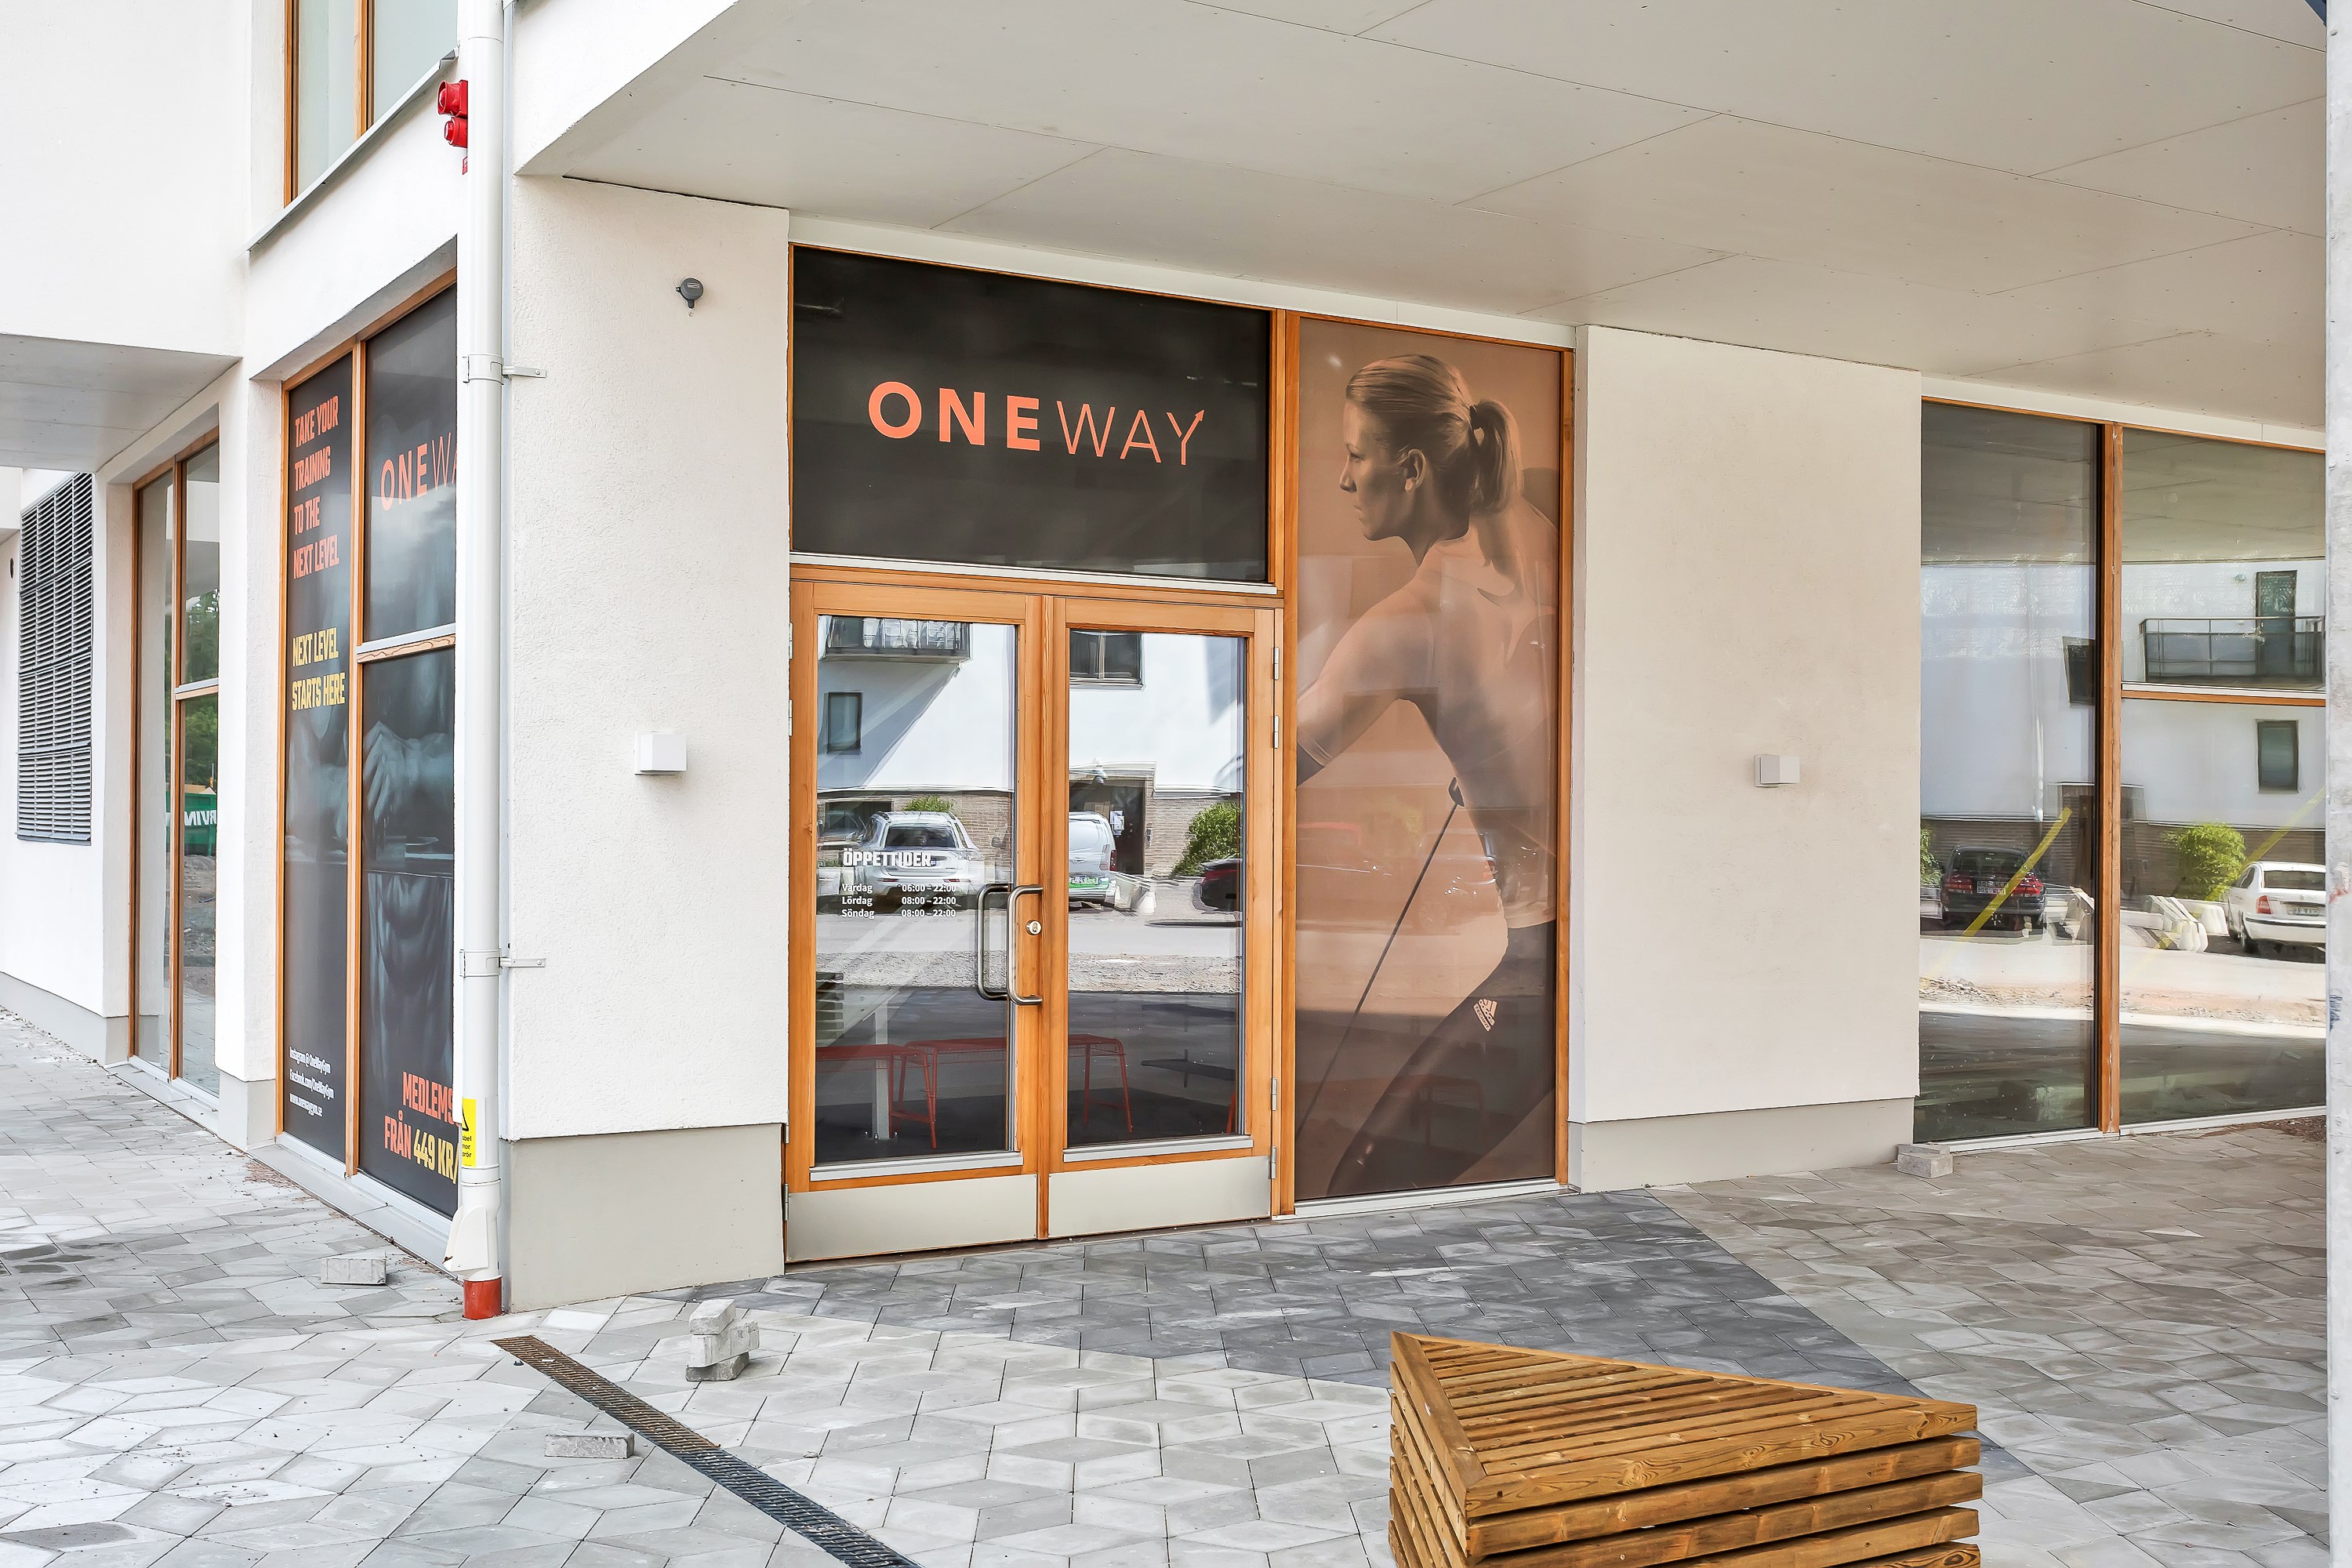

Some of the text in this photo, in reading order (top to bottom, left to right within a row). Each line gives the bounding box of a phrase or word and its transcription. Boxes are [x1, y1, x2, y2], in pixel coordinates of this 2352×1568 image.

[295, 395, 339, 448] TAKE YOUR
[294, 445, 331, 492] TRAINING
[293, 495, 321, 535] TO THE
[293, 534, 339, 579] NEXT LEVEL
[292, 627, 339, 667] NEXT LEVEL
[292, 672, 345, 710] STARTS HERE
[843, 848, 932, 867] ÖPPETTIDER
[841, 884, 873, 894] Vardag
[902, 884, 925, 892] 06:00
[933, 884, 956, 892] 22:00
[841, 896, 873, 906] Lördag
[902, 896, 925, 905] 08:00
[933, 896, 956, 905] 22:00
[841, 909, 875, 919] Söndag
[902, 909, 925, 917] 08:00
[933, 909, 956, 917] 22:00
[384, 1109, 412, 1160] FRÅN
[413, 1128, 435, 1171] 449
